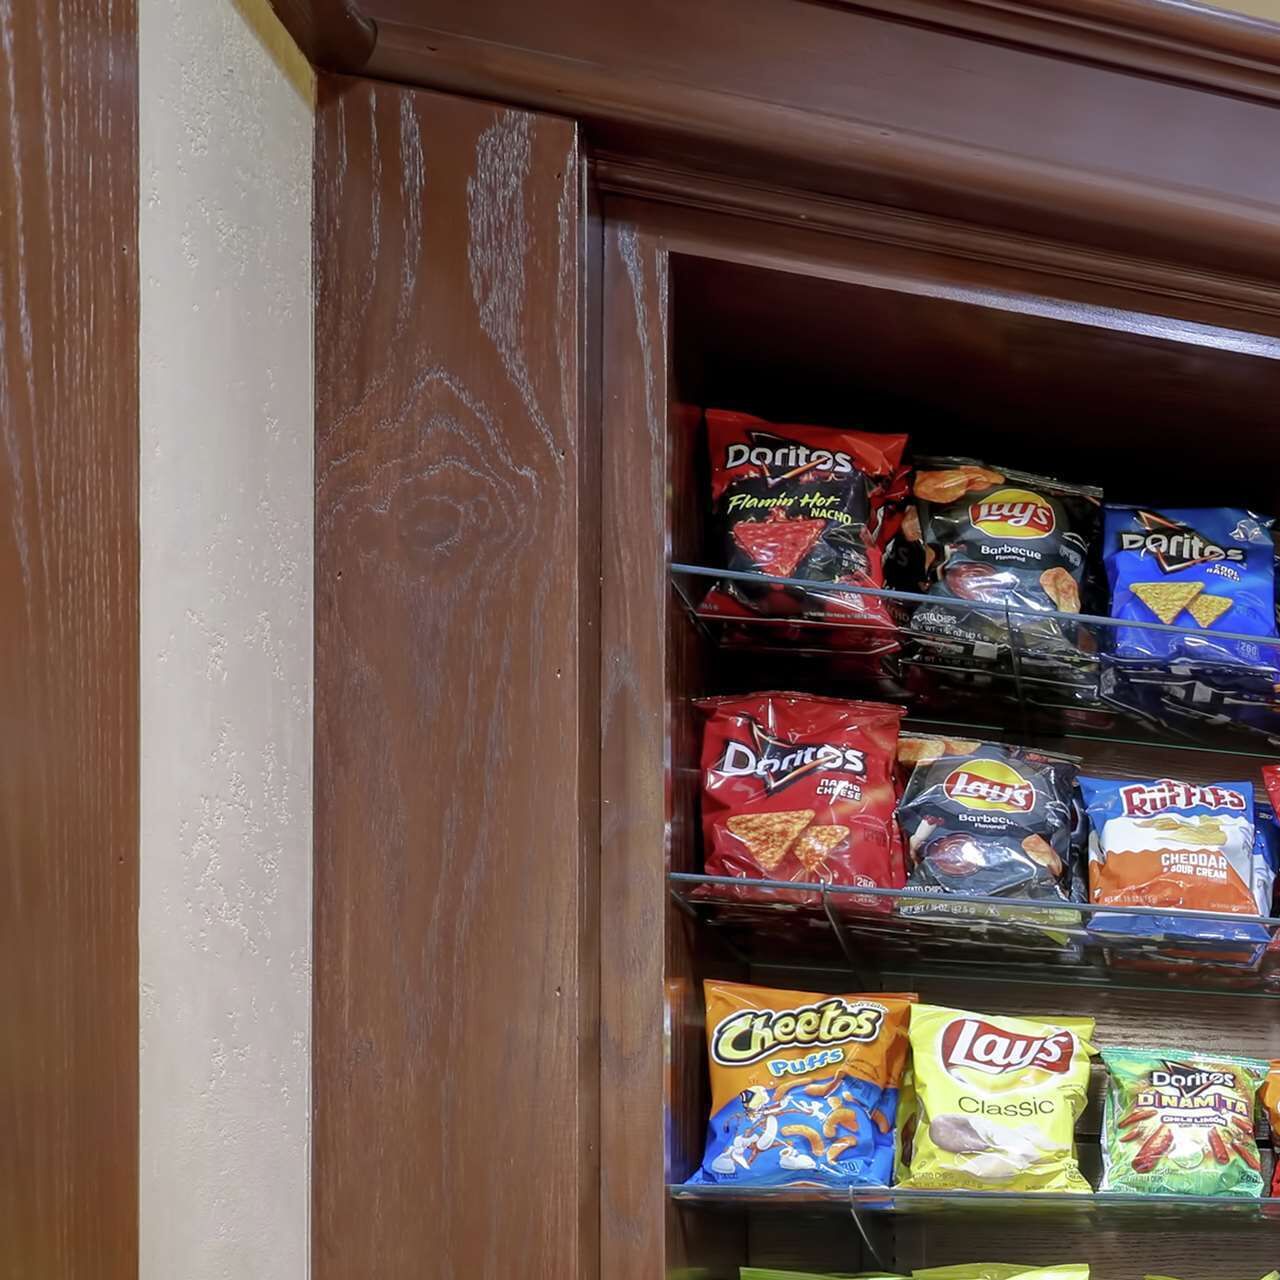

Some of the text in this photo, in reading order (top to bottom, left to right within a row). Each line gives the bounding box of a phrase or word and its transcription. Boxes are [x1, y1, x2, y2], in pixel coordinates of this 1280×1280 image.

[727, 443, 852, 473] Doritos
[728, 492, 841, 510] Flamin' Hot
[811, 508, 851, 524] NACHO
[981, 544, 1041, 560] Barbecue
[1122, 533, 1244, 562] Doritos
[724, 742, 865, 778] Doritos
[954, 773, 1028, 808] Lay's
[1121, 779, 1246, 816] RUFFLES
[1161, 853, 1227, 869] CHEDDAR
[1170, 865, 1227, 880] SOUR CREAM
[715, 1002, 882, 1064] Cheetos
[949, 1019, 1069, 1074] Lay's
[769, 1049, 844, 1077] Puffs
[1153, 1072, 1234, 1087] Doritos
[958, 1096, 1055, 1117] Classic
[1137, 1093, 1248, 1117] DINAMITA
